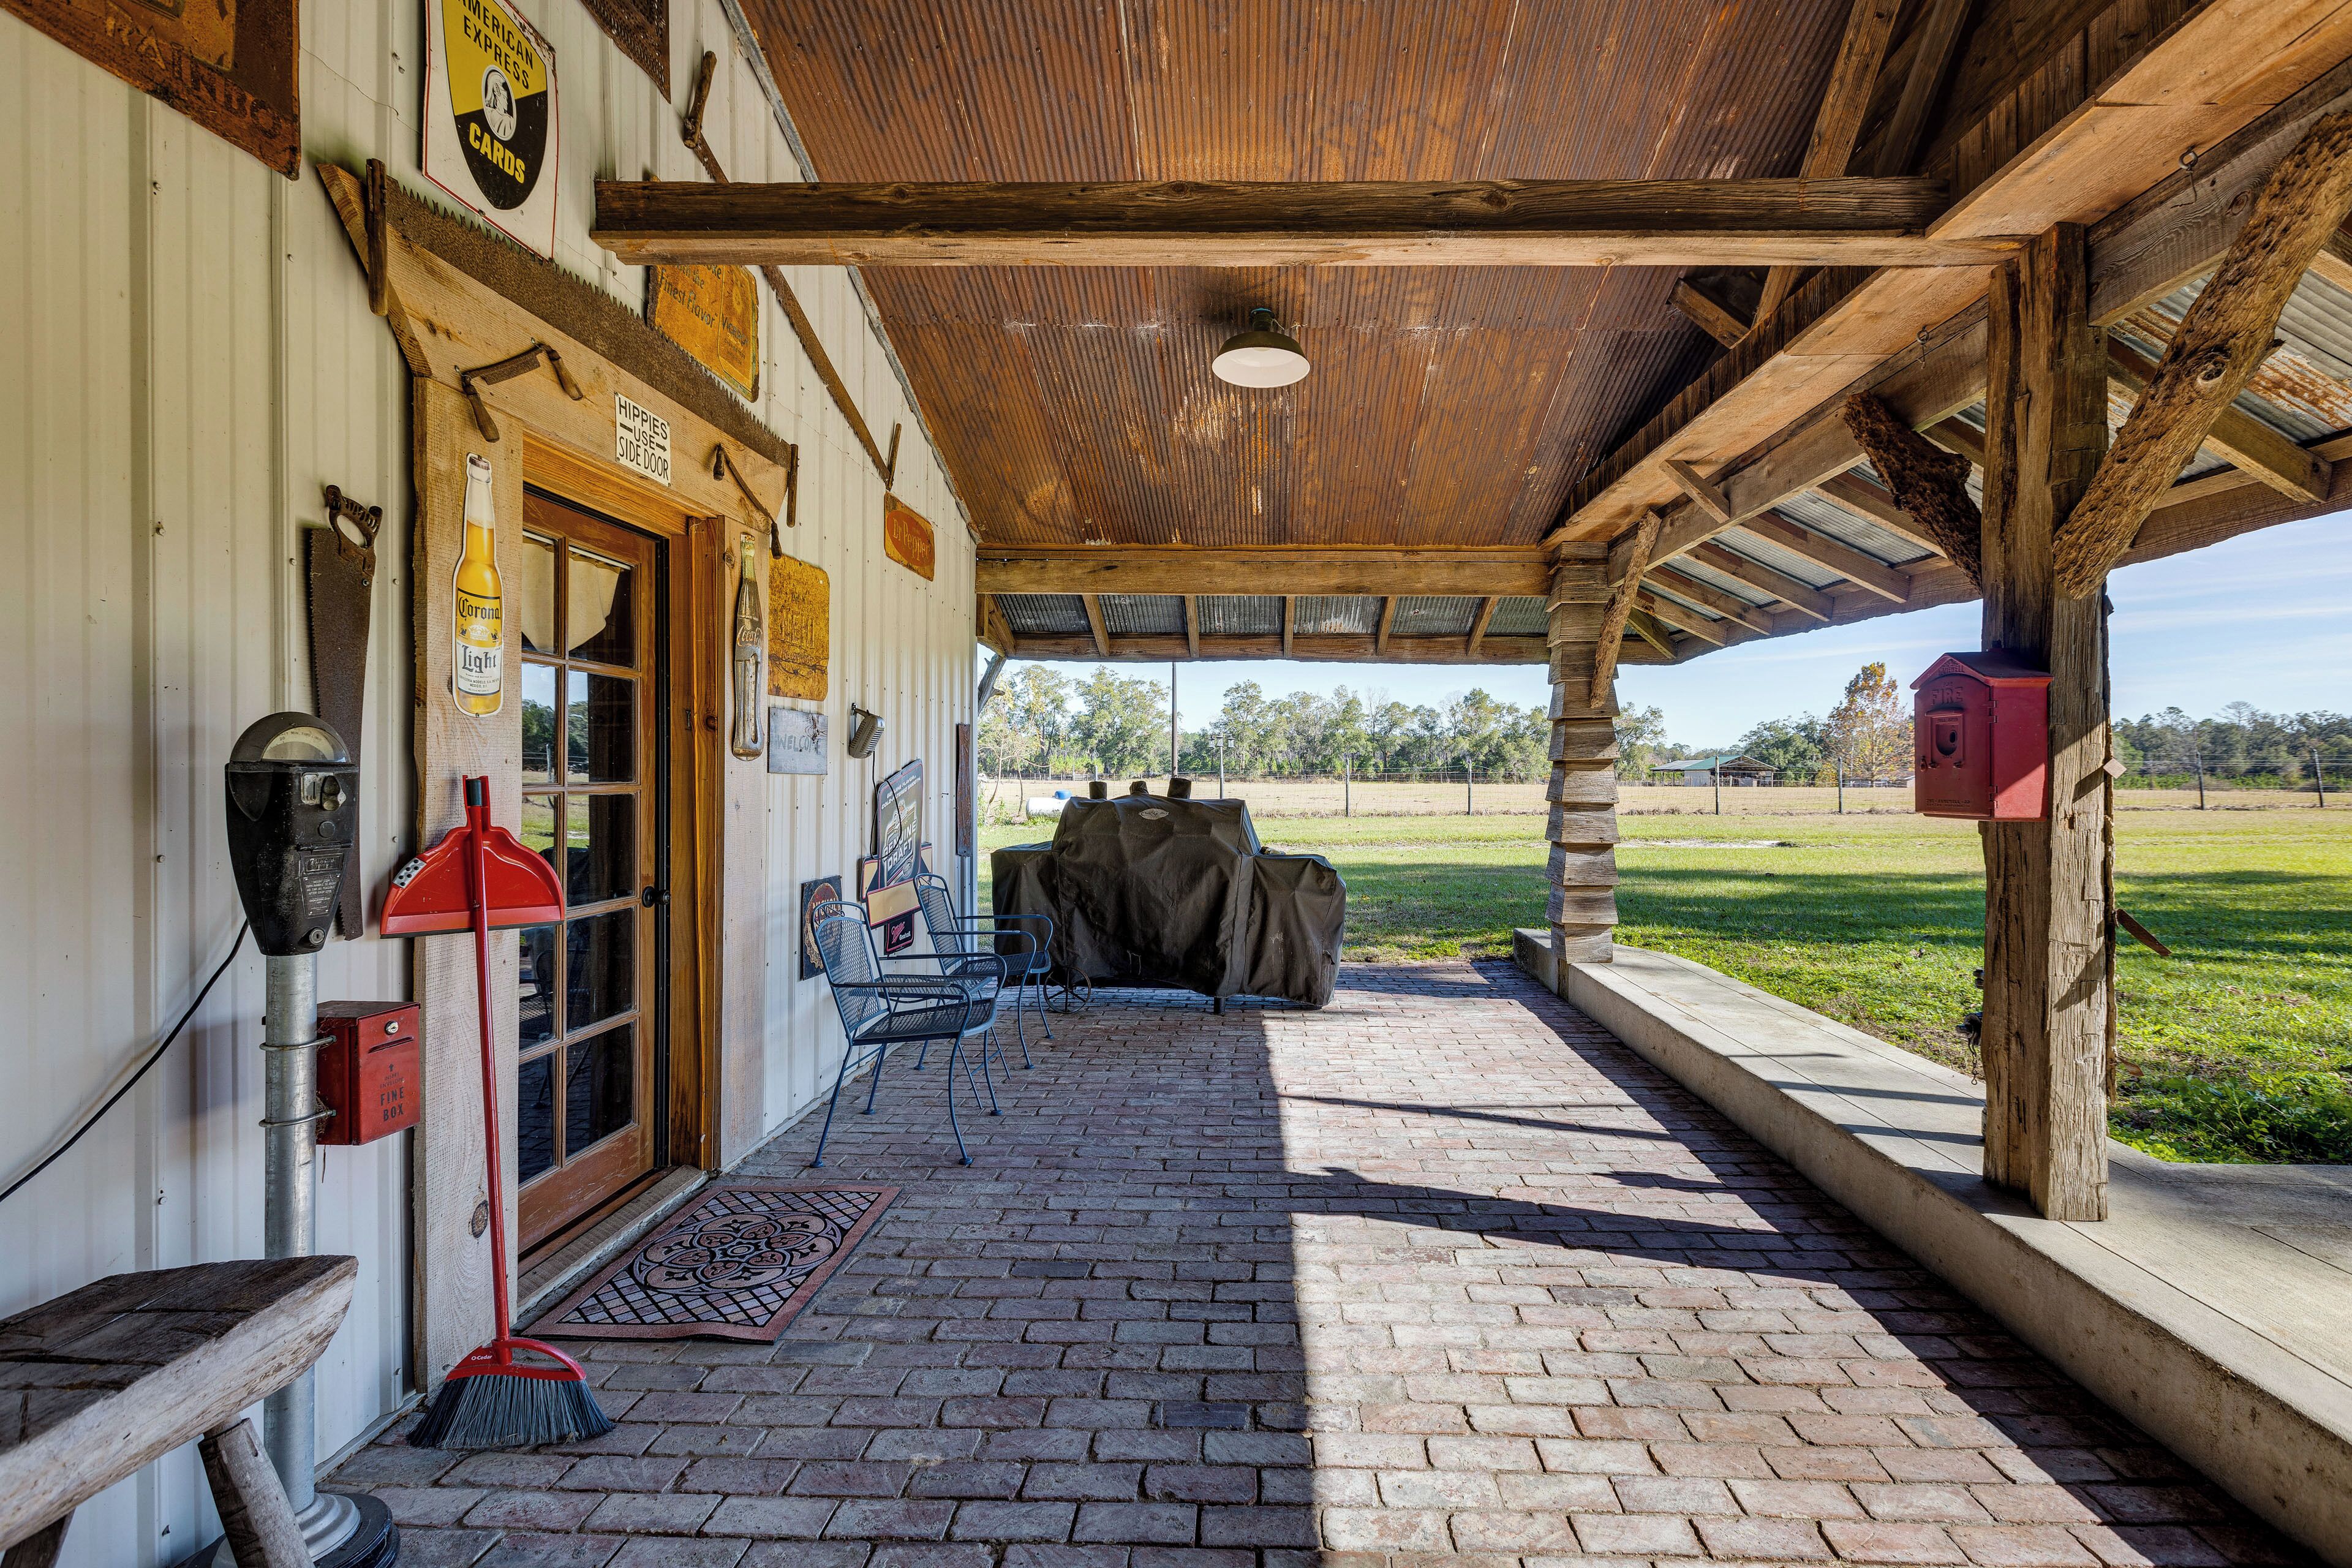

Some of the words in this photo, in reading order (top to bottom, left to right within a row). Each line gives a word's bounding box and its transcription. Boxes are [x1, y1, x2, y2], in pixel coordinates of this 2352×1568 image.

[464, 15, 529, 90] EXPRESS
[469, 123, 526, 184] CARDS
[658, 269, 685, 306] Finest
[619, 397, 668, 440] HIPPIES
[634, 425, 655, 451] USE
[619, 436, 641, 467] SIDE
[644, 448, 669, 481] DOOR
[892, 518, 902, 541] Dr
[902, 520, 930, 562] Pepper
[458, 596, 500, 621] Corona
[461, 644, 497, 673] Light
[1931, 686, 1964, 706] FIRE
[883, 820, 918, 862] GENUINE
[887, 837, 913, 872] DRAFT
[380, 1077, 405, 1089] ENVELOPE
[380, 1086, 404, 1107] FINE
[383, 1102, 404, 1122] BOX
